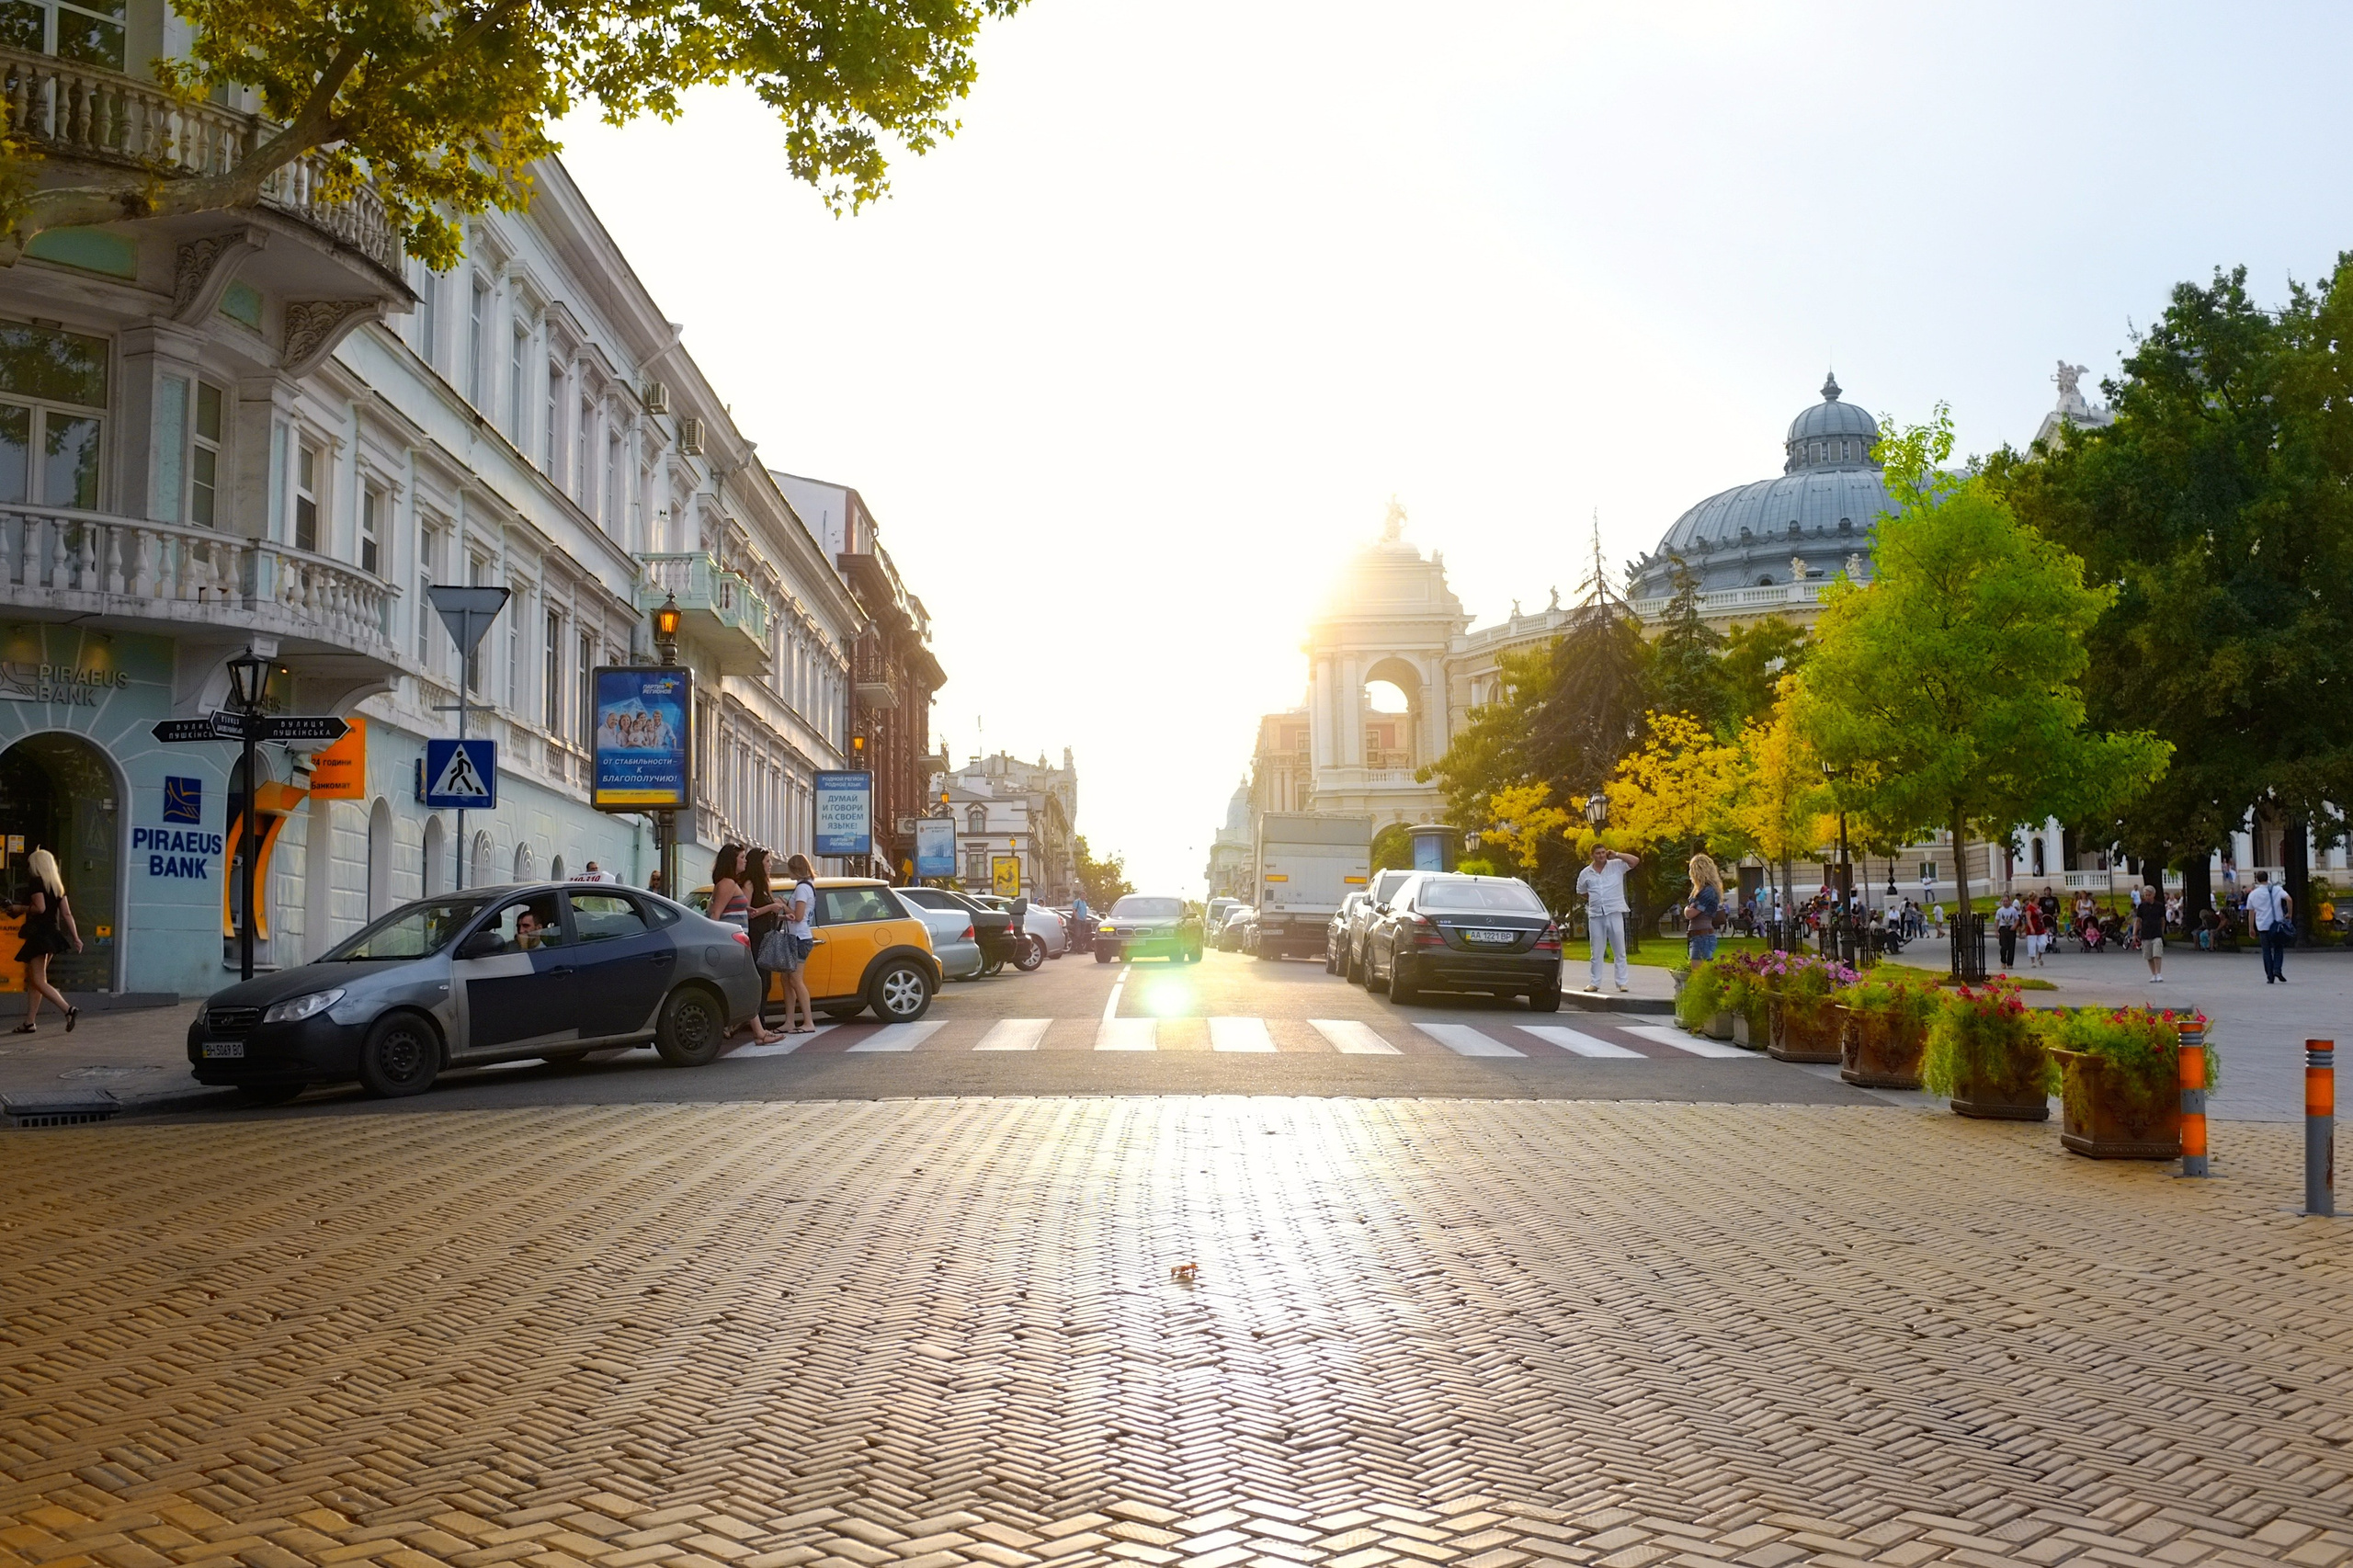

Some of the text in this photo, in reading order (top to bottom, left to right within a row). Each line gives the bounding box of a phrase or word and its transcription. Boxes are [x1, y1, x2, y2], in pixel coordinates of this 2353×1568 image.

[38, 664, 130, 689] PIRAEUS
[38, 684, 97, 707] BANK
[273, 727, 331, 736] ПУШКІНСЬКА
[311, 781, 351, 790] Банкомат
[827, 794, 858, 802] ДУМАЙ
[132, 827, 222, 855] PIRAEUS
[149, 855, 208, 880] BANK
[1471, 931, 1482, 939] AA
[1483, 932, 1500, 940] 1221
